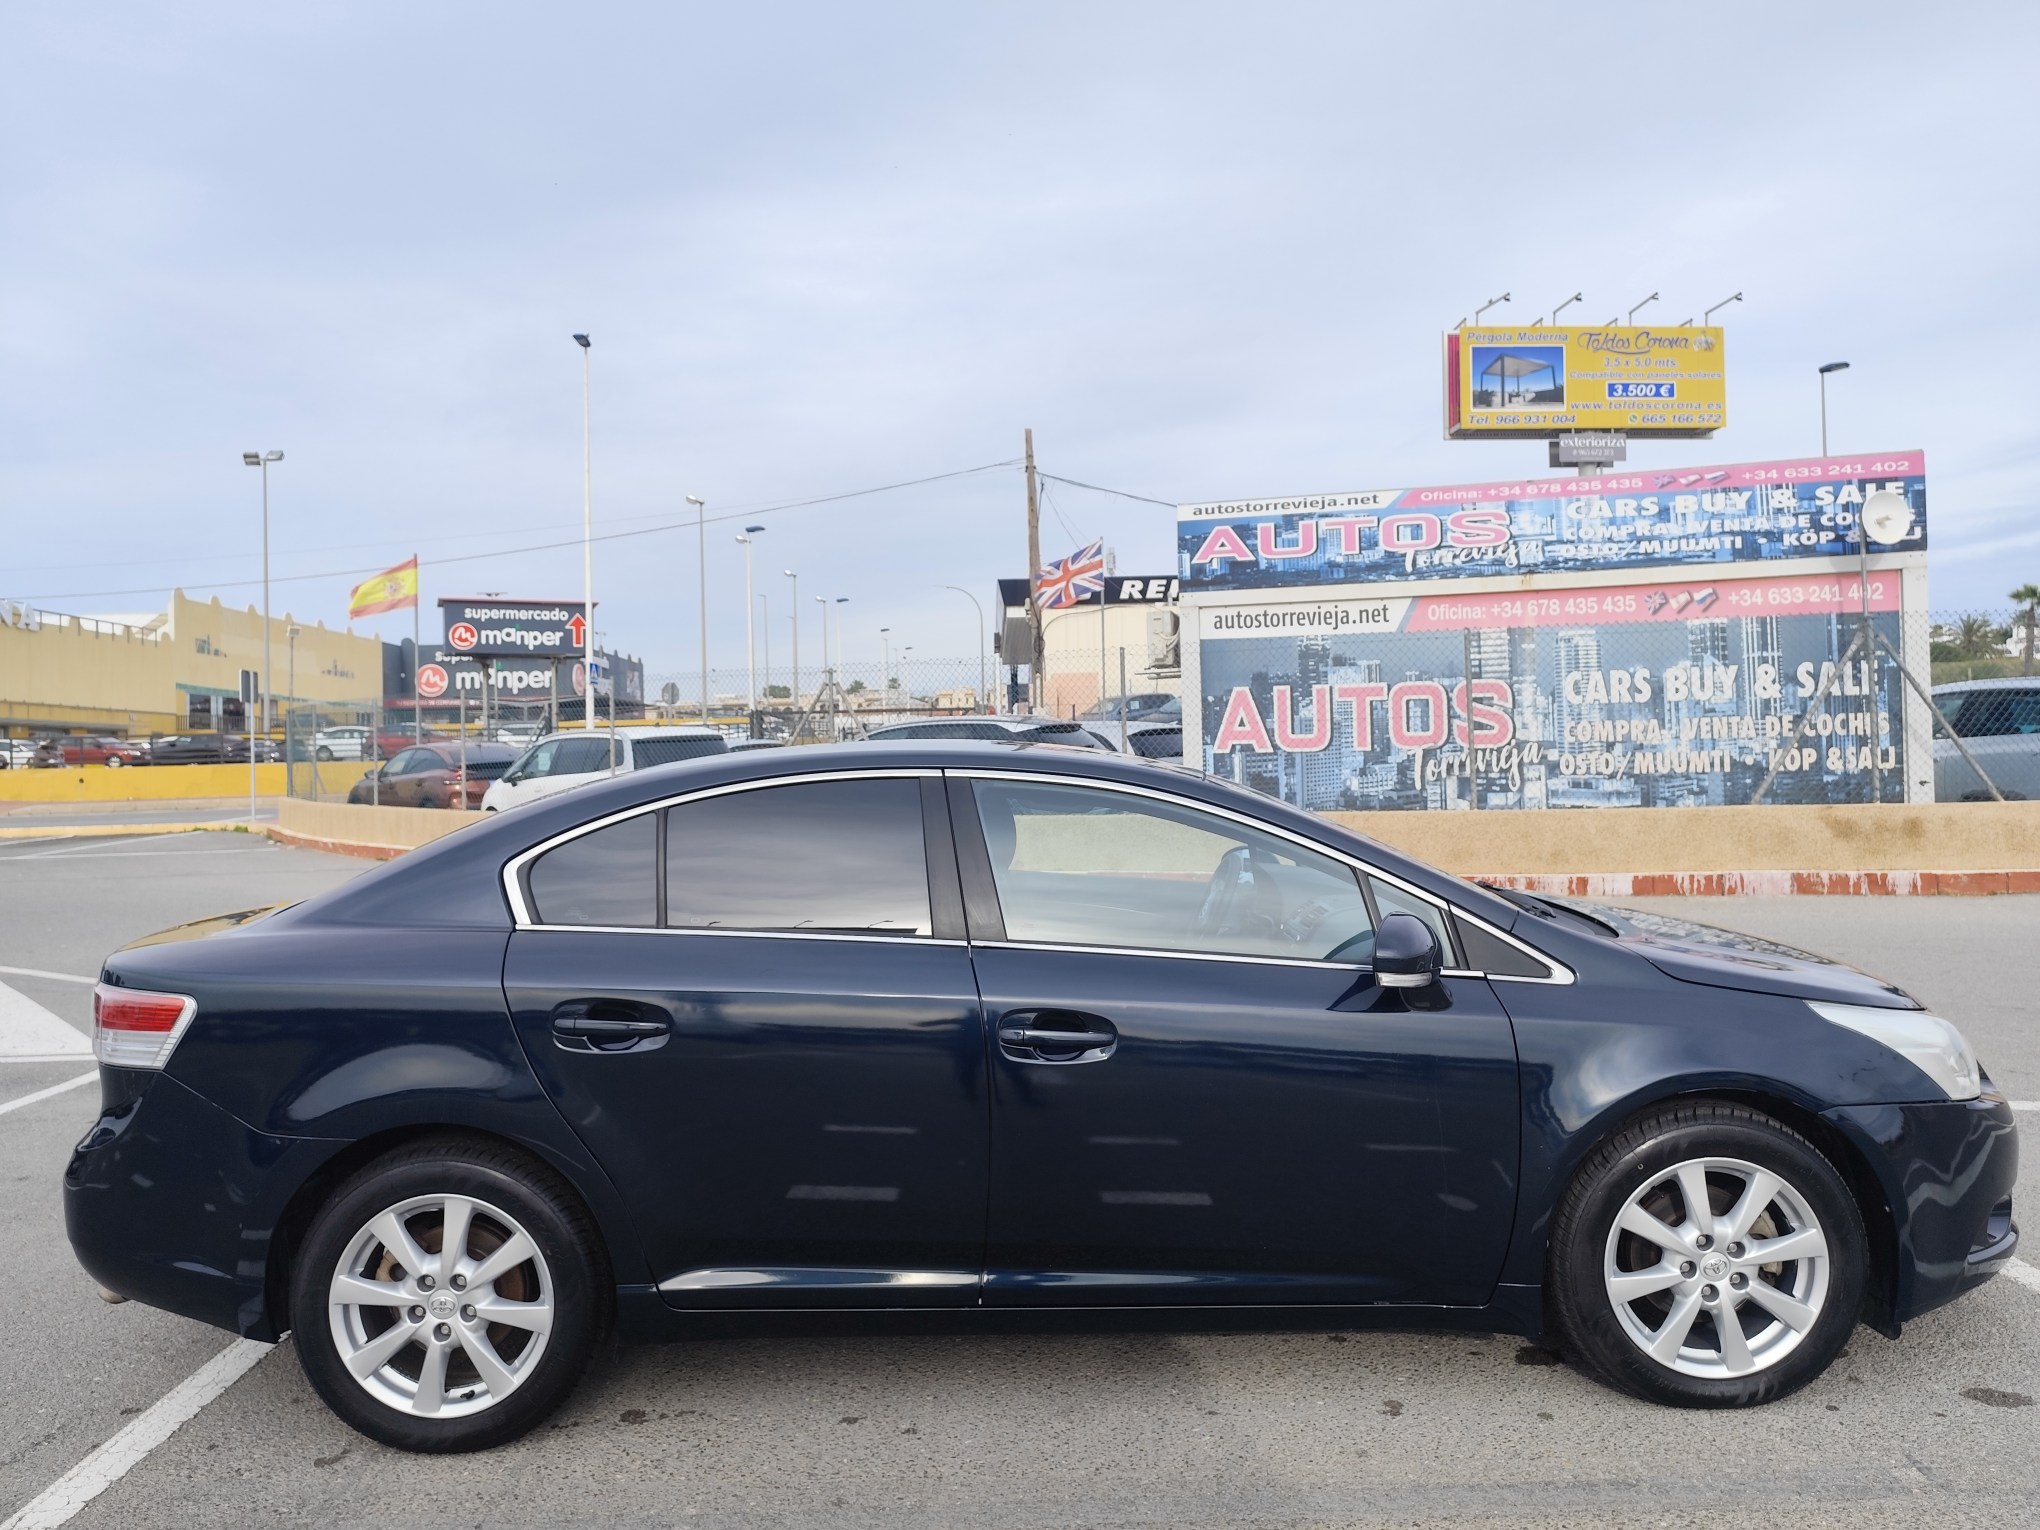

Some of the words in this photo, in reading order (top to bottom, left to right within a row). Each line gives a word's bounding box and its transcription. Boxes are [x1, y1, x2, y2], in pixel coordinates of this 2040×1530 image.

[1517, 332, 1568, 341] Moderna
[1576, 331, 1631, 350] Toldos
[1634, 331, 1689, 350] Corona
[1612, 384, 1656, 397] 3.500
[1659, 384, 1671, 397] €
[1495, 415, 1521, 425] 966
[1641, 414, 1667, 424] 665
[1672, 414, 1694, 424] 166
[1560, 434, 1626, 448] exterioriza
[1193, 493, 1380, 516] autostorrevieja.net
[1420, 490, 1483, 501] Oficina:
[1488, 486, 1521, 497] +34
[1526, 483, 1562, 494] 678
[1566, 480, 1602, 491] 435
[1606, 478, 1643, 489] 435
[1741, 469, 1778, 481] +34
[1784, 467, 1822, 478] 633
[1828, 464, 1865, 475] 241
[1871, 461, 1909, 472] 402
[1566, 497, 1660, 519] CARS
[1674, 491, 1752, 514] BUY
[1769, 488, 1798, 508] &
[1780, 514, 1811, 529] DE
[1191, 510, 1513, 564] AUTOS
[1783, 529, 1836, 547] KÖP
[464, 607, 569, 622] supermercado
[1213, 604, 1390, 631] autostorrevieja.net
[1427, 604, 1487, 620] Oficina:
[1491, 601, 1523, 617] +34
[1527, 599, 1561, 616] 678
[1564, 597, 1598, 614] 435
[1602, 595, 1637, 613] 435
[1728, 589, 1763, 606] +34
[1768, 586, 1804, 604] 633
[1808, 584, 1843, 602] 241
[1848, 582, 1884, 600] 402
[480, 626, 564, 650] manper
[1564, 667, 1652, 704] CARS
[1666, 665, 1739, 702] BUY
[1755, 663, 1783, 699] &
[1213, 678, 1516, 754] AUTOS
[1564, 719, 1662, 742] COMPRA
[1683, 716, 1757, 739] VENTA
[1765, 714, 1794, 737] DE
[1406, 739, 1544, 792] Torrvieja
